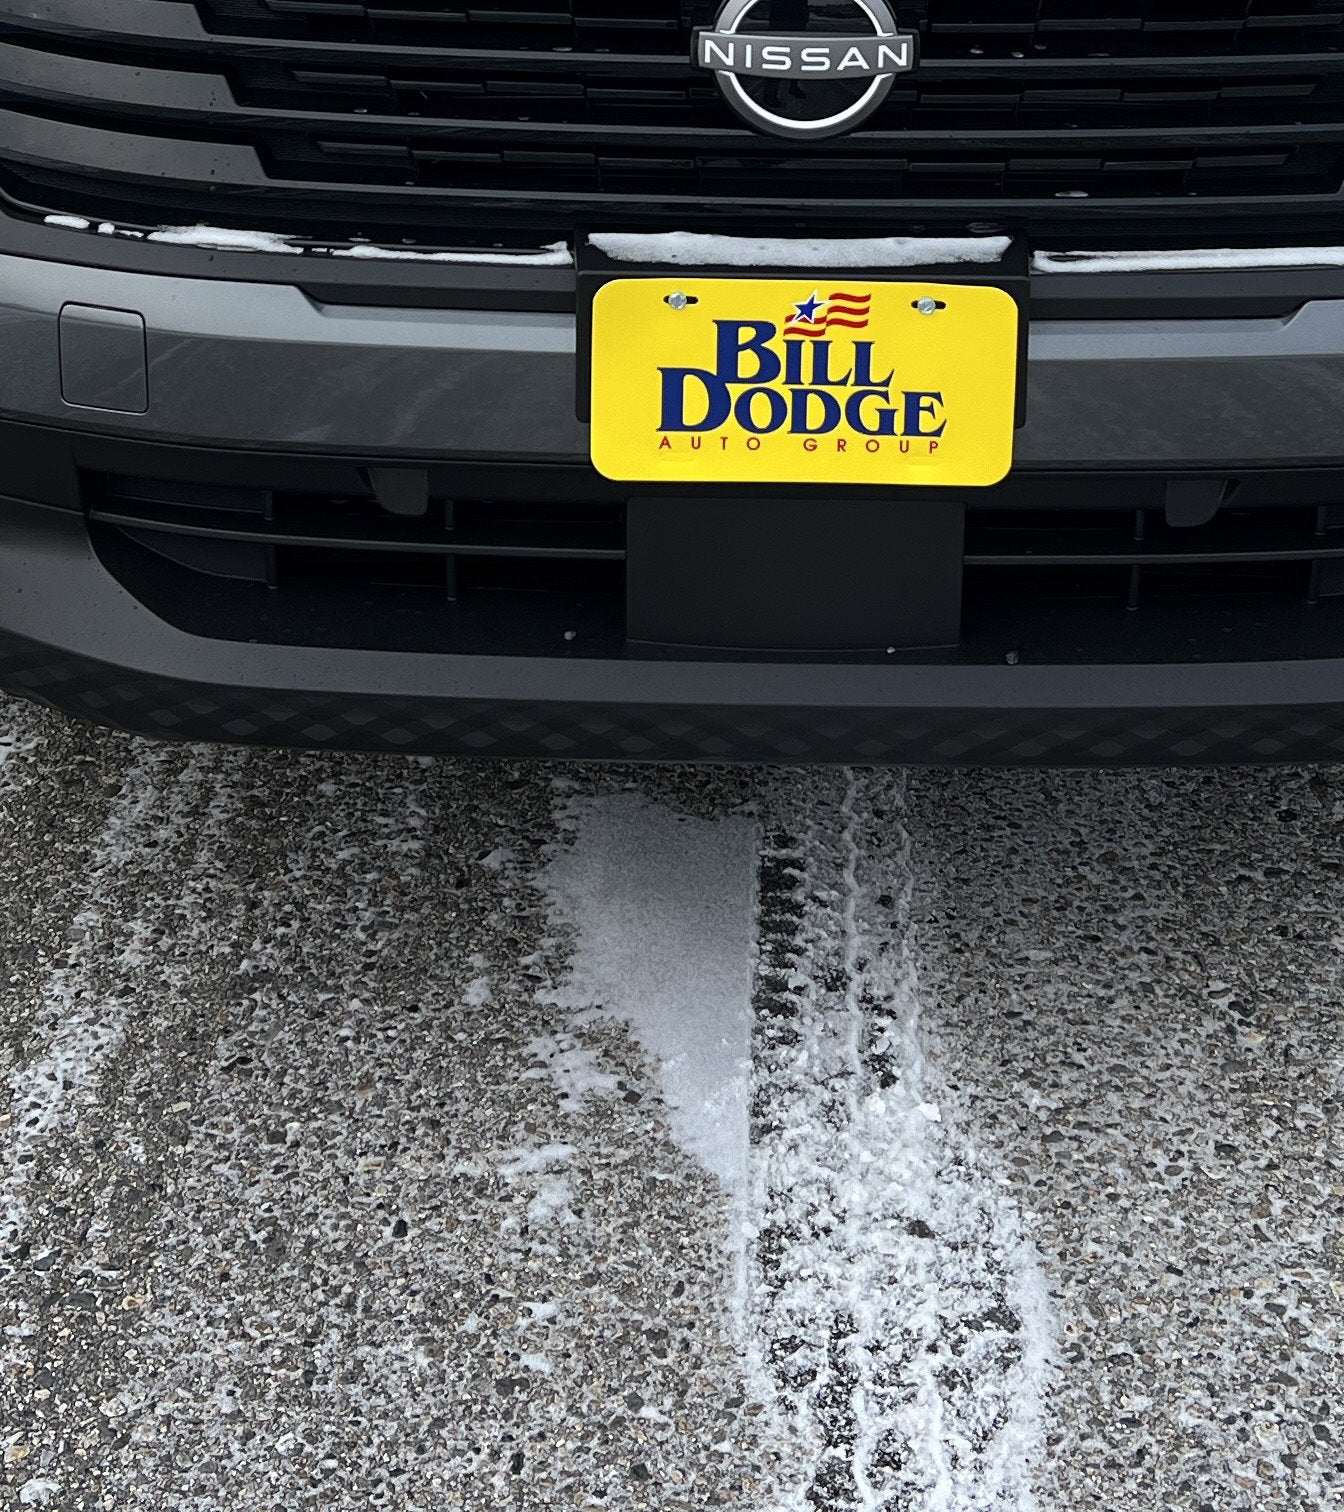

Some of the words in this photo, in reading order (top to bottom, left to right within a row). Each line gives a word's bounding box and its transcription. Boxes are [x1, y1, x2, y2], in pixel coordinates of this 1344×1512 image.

[704, 39, 907, 71] NISSAN
[712, 320, 894, 387] BILL
[657, 367, 947, 437] DODGE
[658, 436, 761, 451] AUTO
[803, 438, 939, 454] GROUP
